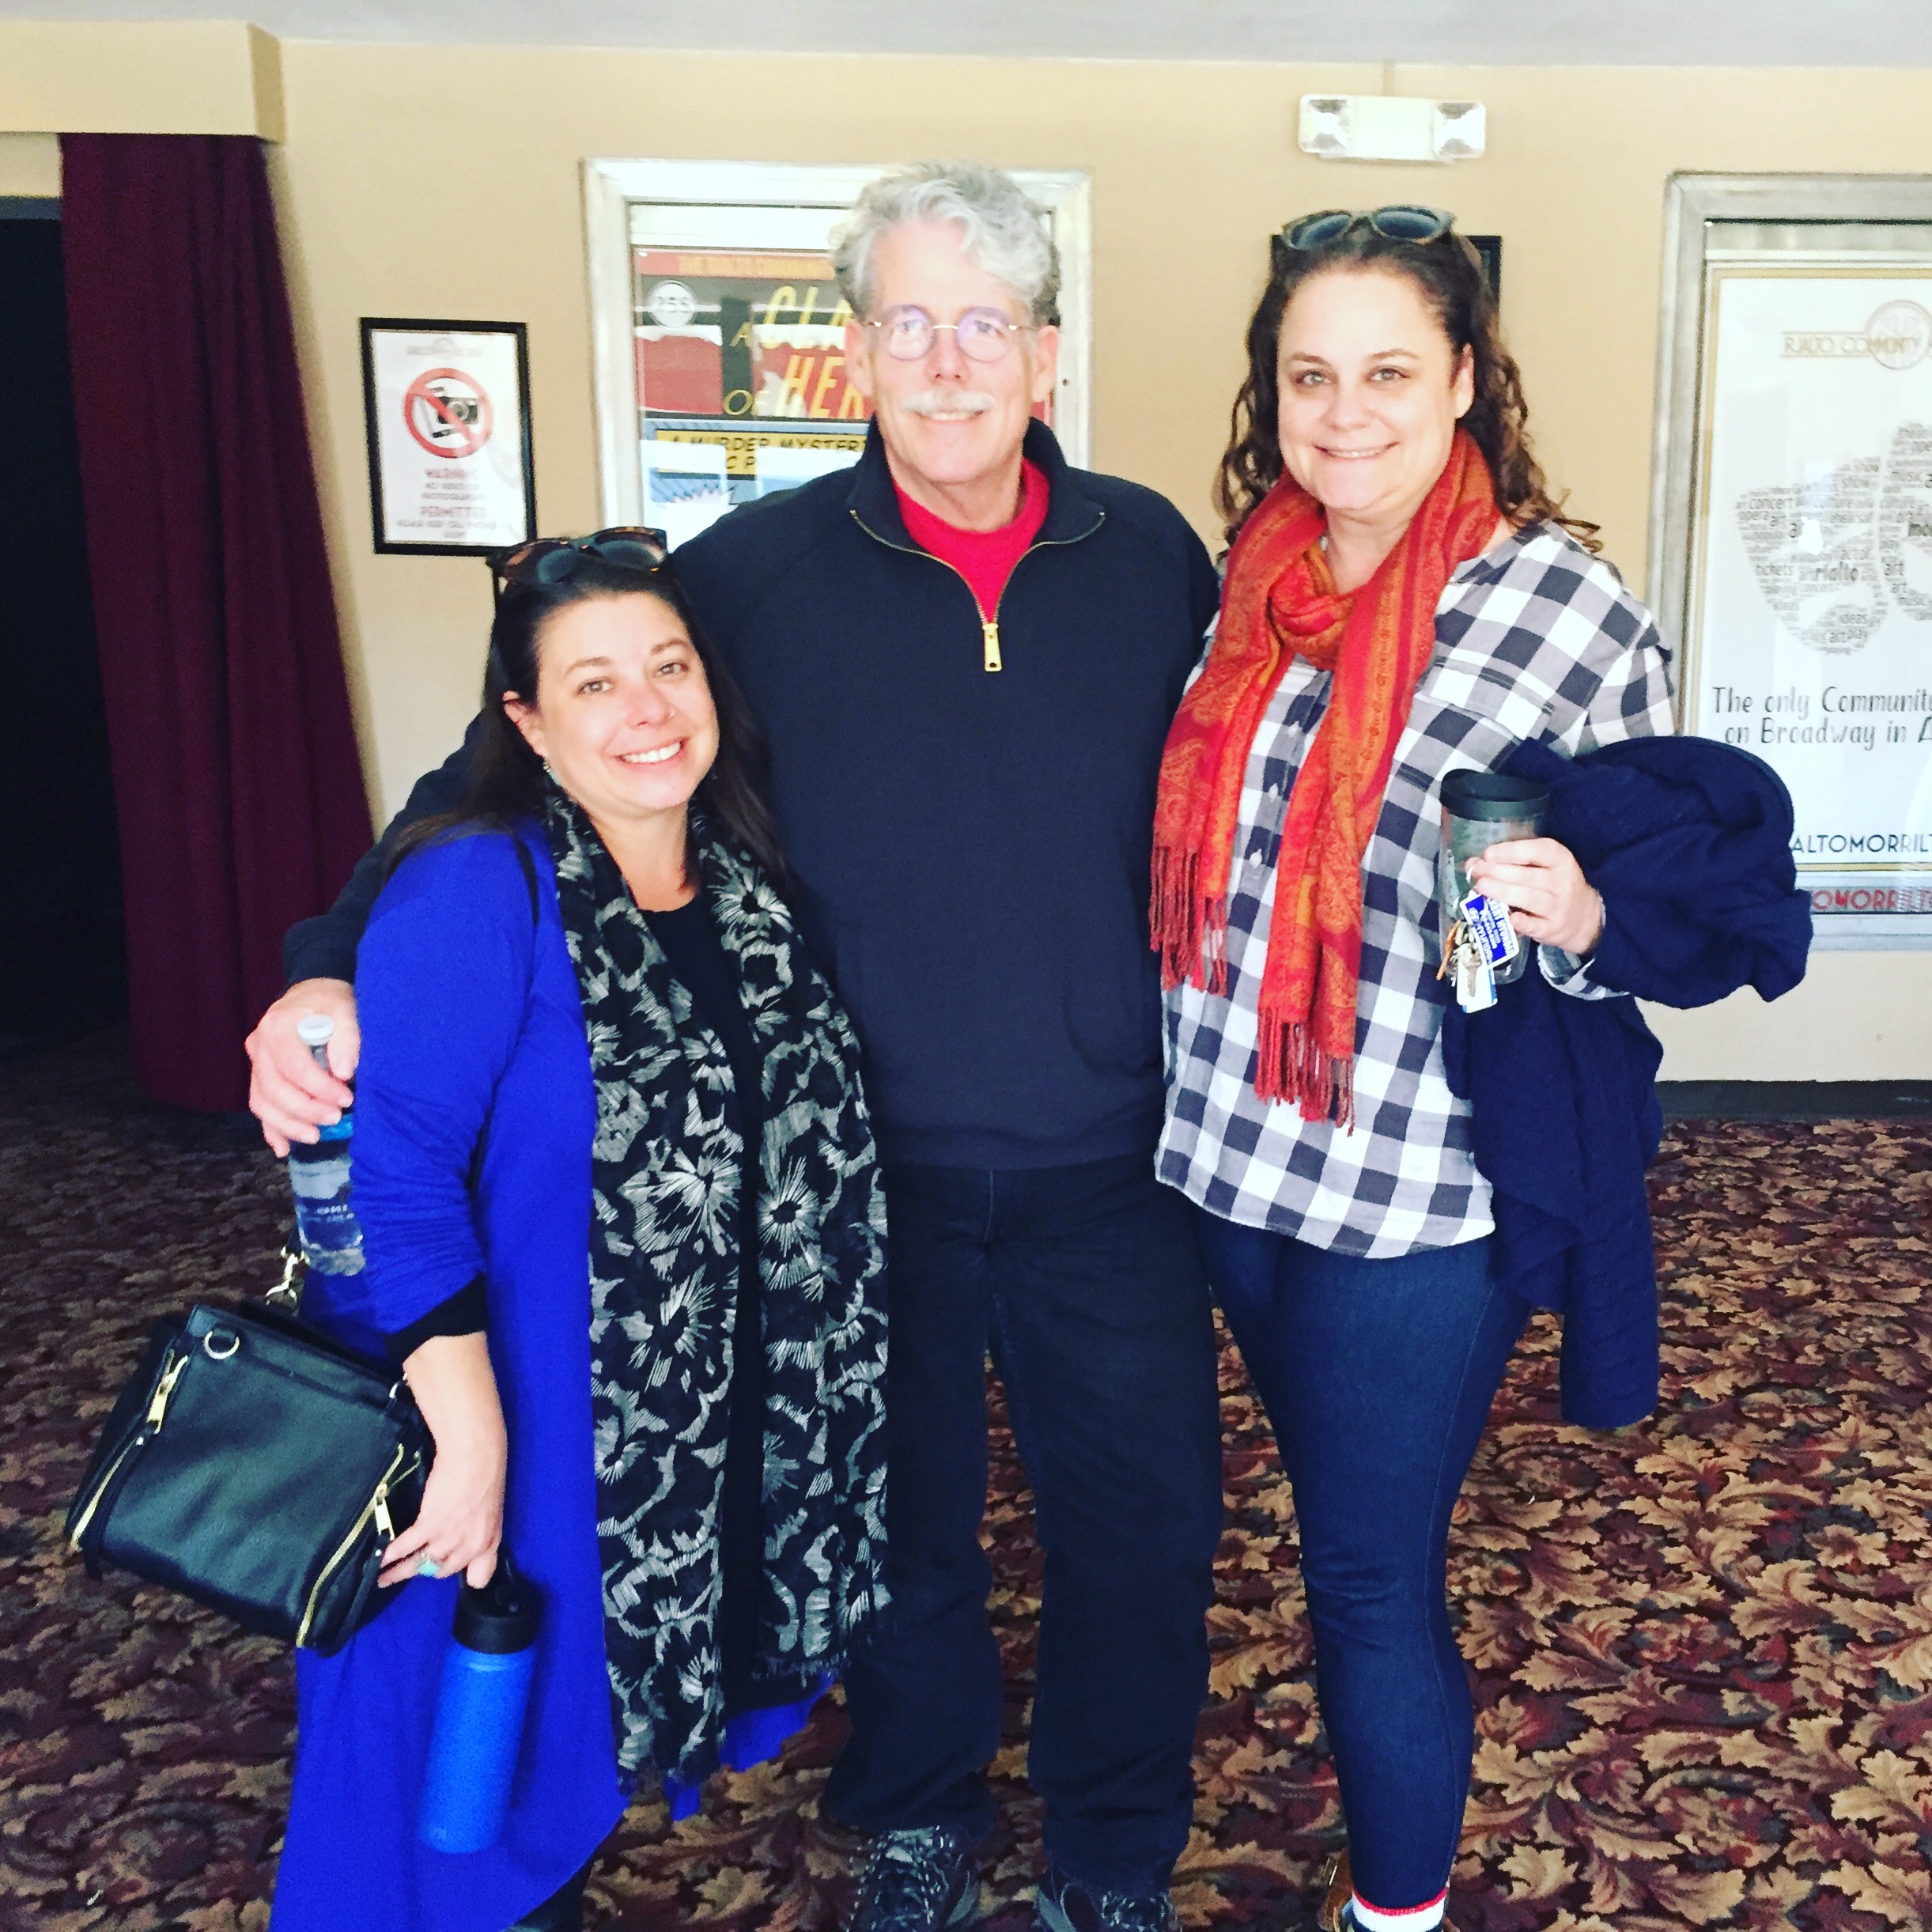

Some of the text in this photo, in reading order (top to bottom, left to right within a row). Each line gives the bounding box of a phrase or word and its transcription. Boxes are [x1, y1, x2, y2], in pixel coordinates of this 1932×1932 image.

[1712, 686, 1753, 713] The
[1764, 686, 1810, 720] only
[1725, 726, 1750, 743] on
[1760, 717, 1875, 751] Broadway
[1886, 720, 1907, 743] in
[1791, 834, 1932, 853] ALTOMORRIL
